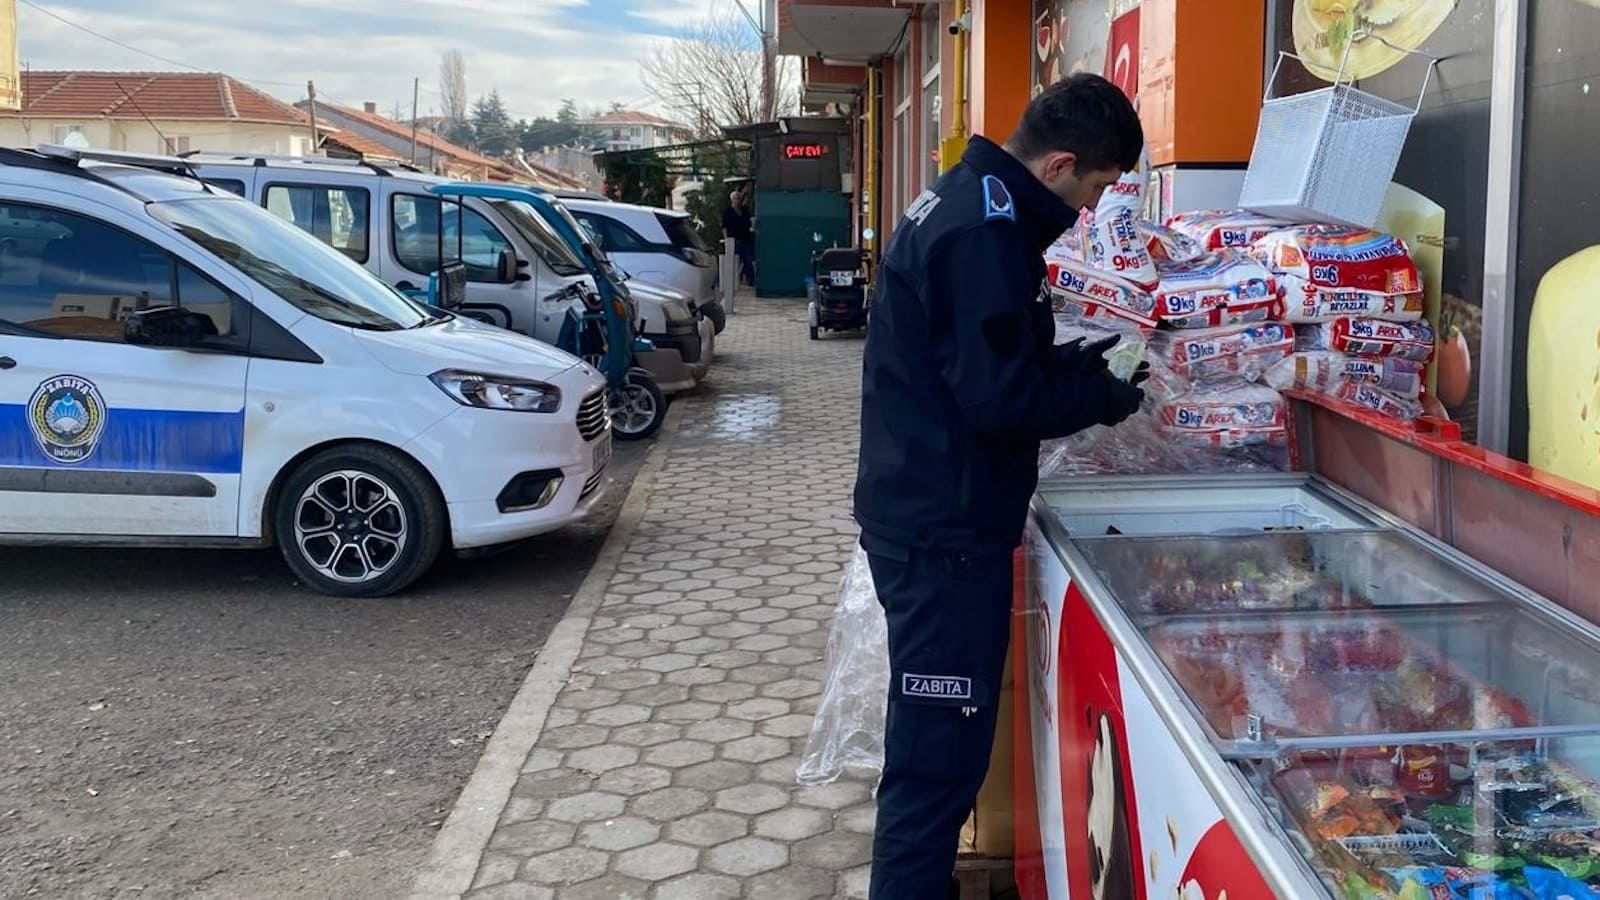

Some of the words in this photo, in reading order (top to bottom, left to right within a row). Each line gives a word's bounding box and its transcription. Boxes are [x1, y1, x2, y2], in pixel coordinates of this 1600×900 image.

[786, 145, 804, 158] ÇAY
[1111, 182, 1140, 197] AREX
[1223, 231, 1246, 244] 9kg
[1112, 254, 1139, 271] 9kg
[1312, 264, 1338, 283] 9KG
[1059, 270, 1085, 293] 9kg
[1087, 284, 1118, 301] AREX
[1169, 296, 1195, 312] 9kg
[1200, 295, 1230, 307] AREX
[1352, 321, 1373, 337] 9kg
[47, 379, 90, 395] ZABITA
[1178, 409, 1203, 425] 9kg
[1205, 413, 1235, 424] AREX
[910, 678, 962, 694] ZABITA
